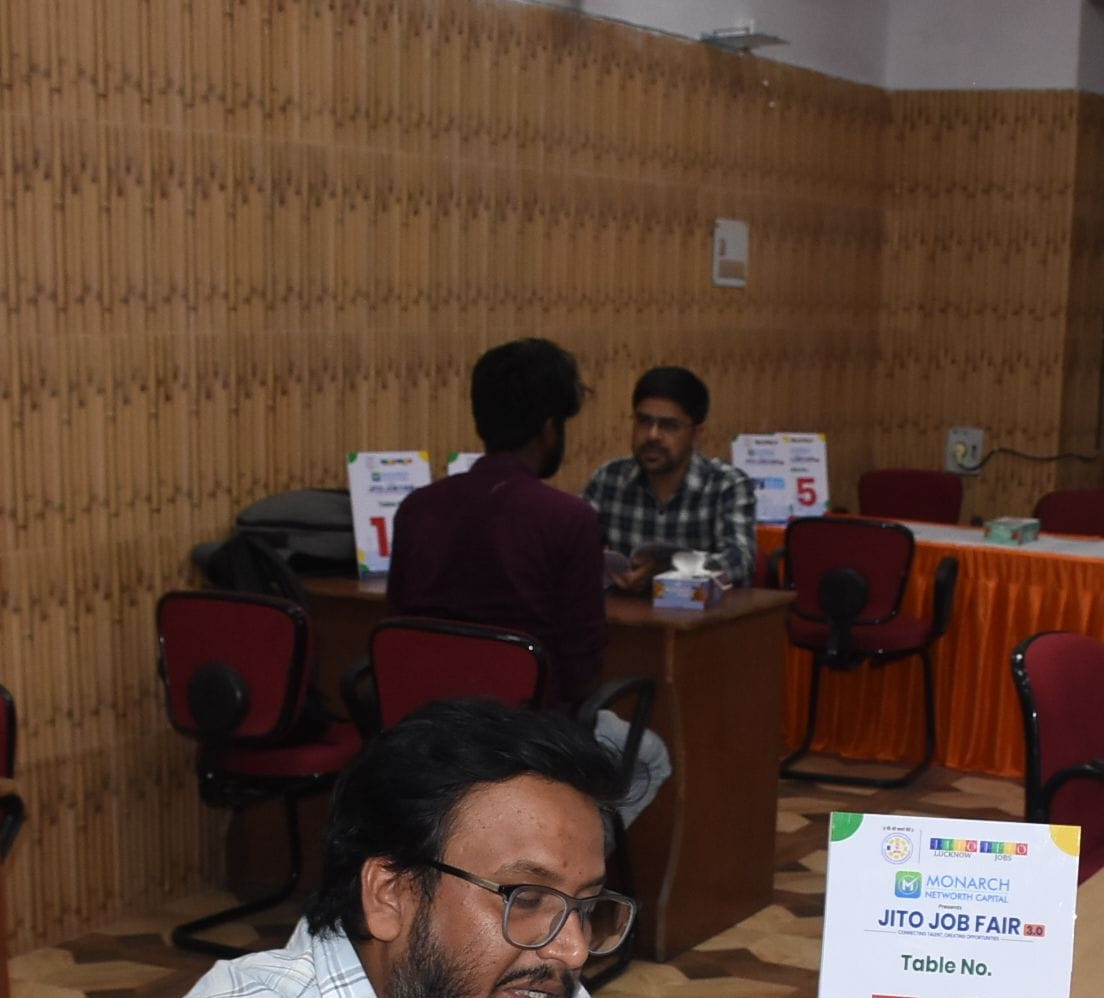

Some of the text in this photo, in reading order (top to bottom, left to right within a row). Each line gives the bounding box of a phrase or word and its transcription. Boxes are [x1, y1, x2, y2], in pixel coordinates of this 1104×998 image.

[797, 477, 817, 507] 5
[370, 516, 390, 557] 1
[934, 851, 1012, 862] LUCKNOW JOBS
[927, 875, 1010, 892] MONARCH
[925, 891, 1008, 904] NETWORTH CAPITAL
[878, 909, 1043, 937] JITO JOB FAIR 3.0
[901, 954, 992, 977] Table No.
